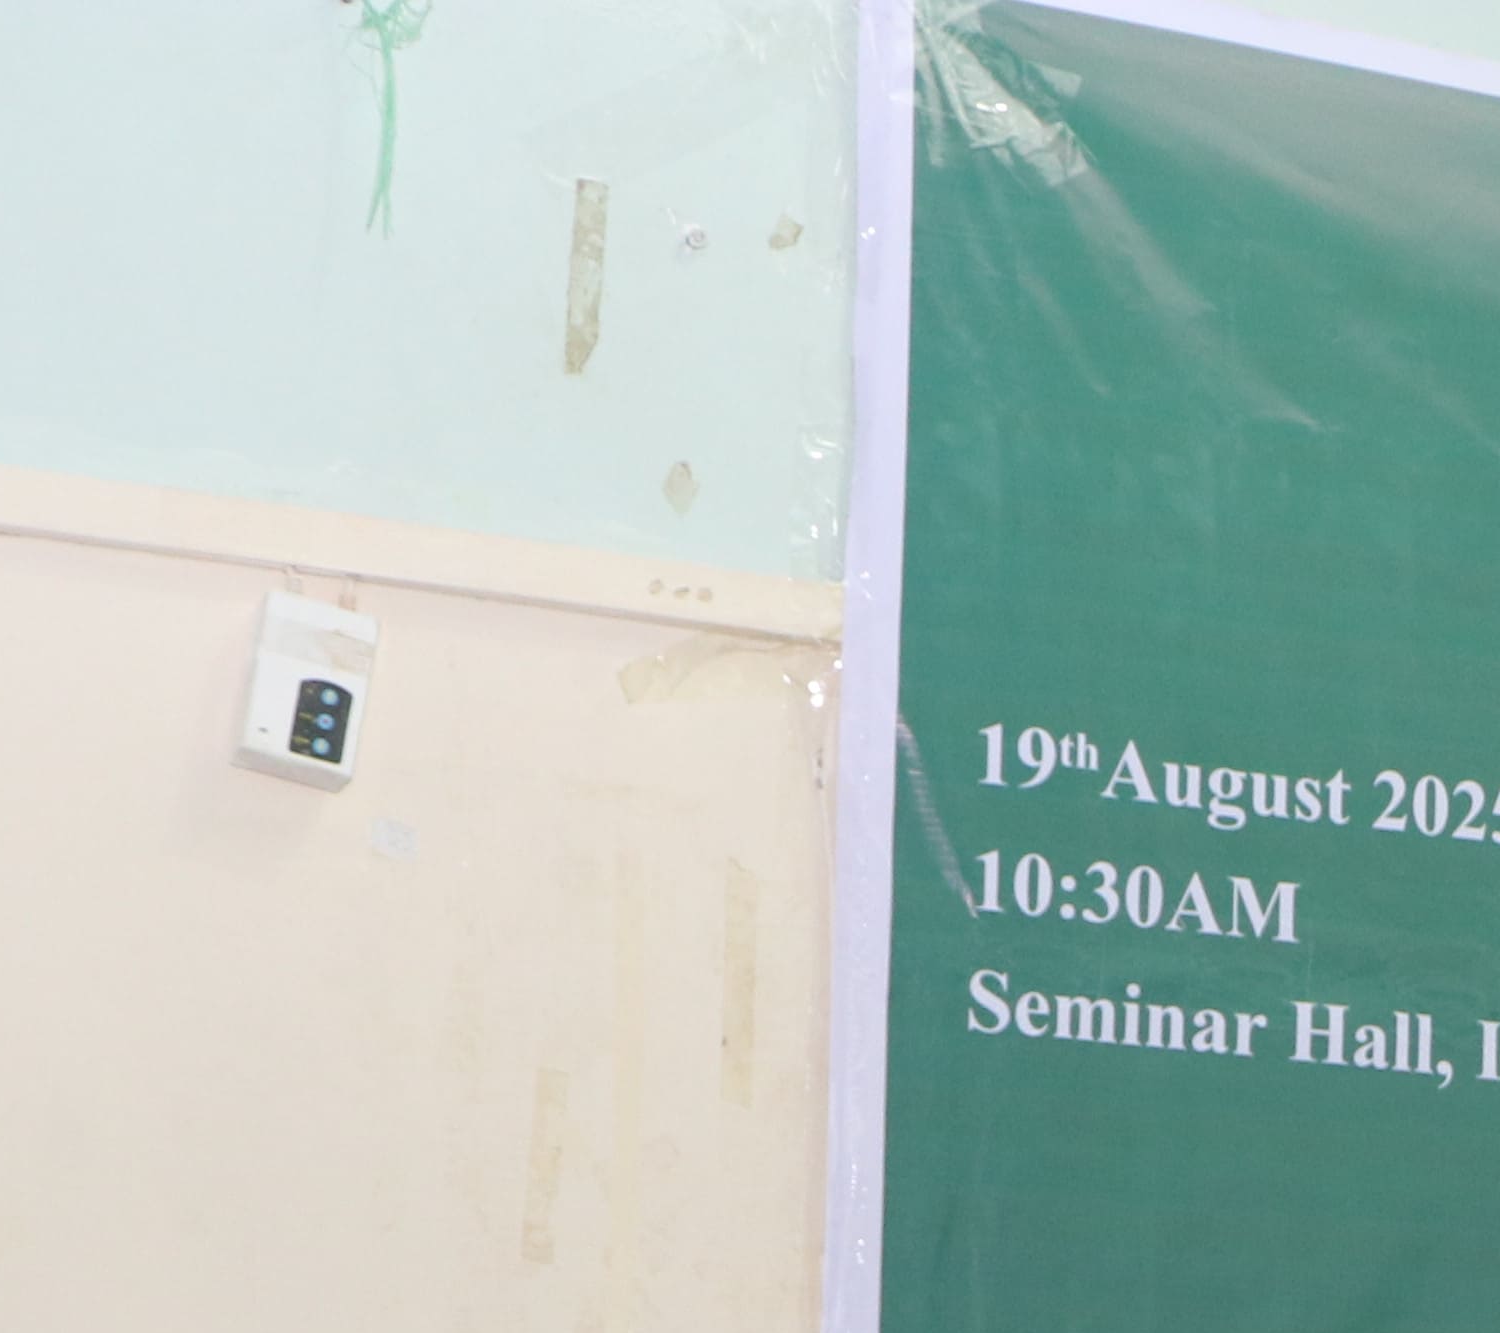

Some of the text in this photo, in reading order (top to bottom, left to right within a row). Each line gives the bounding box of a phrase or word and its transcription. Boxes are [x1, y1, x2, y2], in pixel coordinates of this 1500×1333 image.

[973, 849, 1301, 943] 10:30AM
[966, 968, 1267, 1059] Seminar
[1289, 1000, 1456, 1089] Hall,
